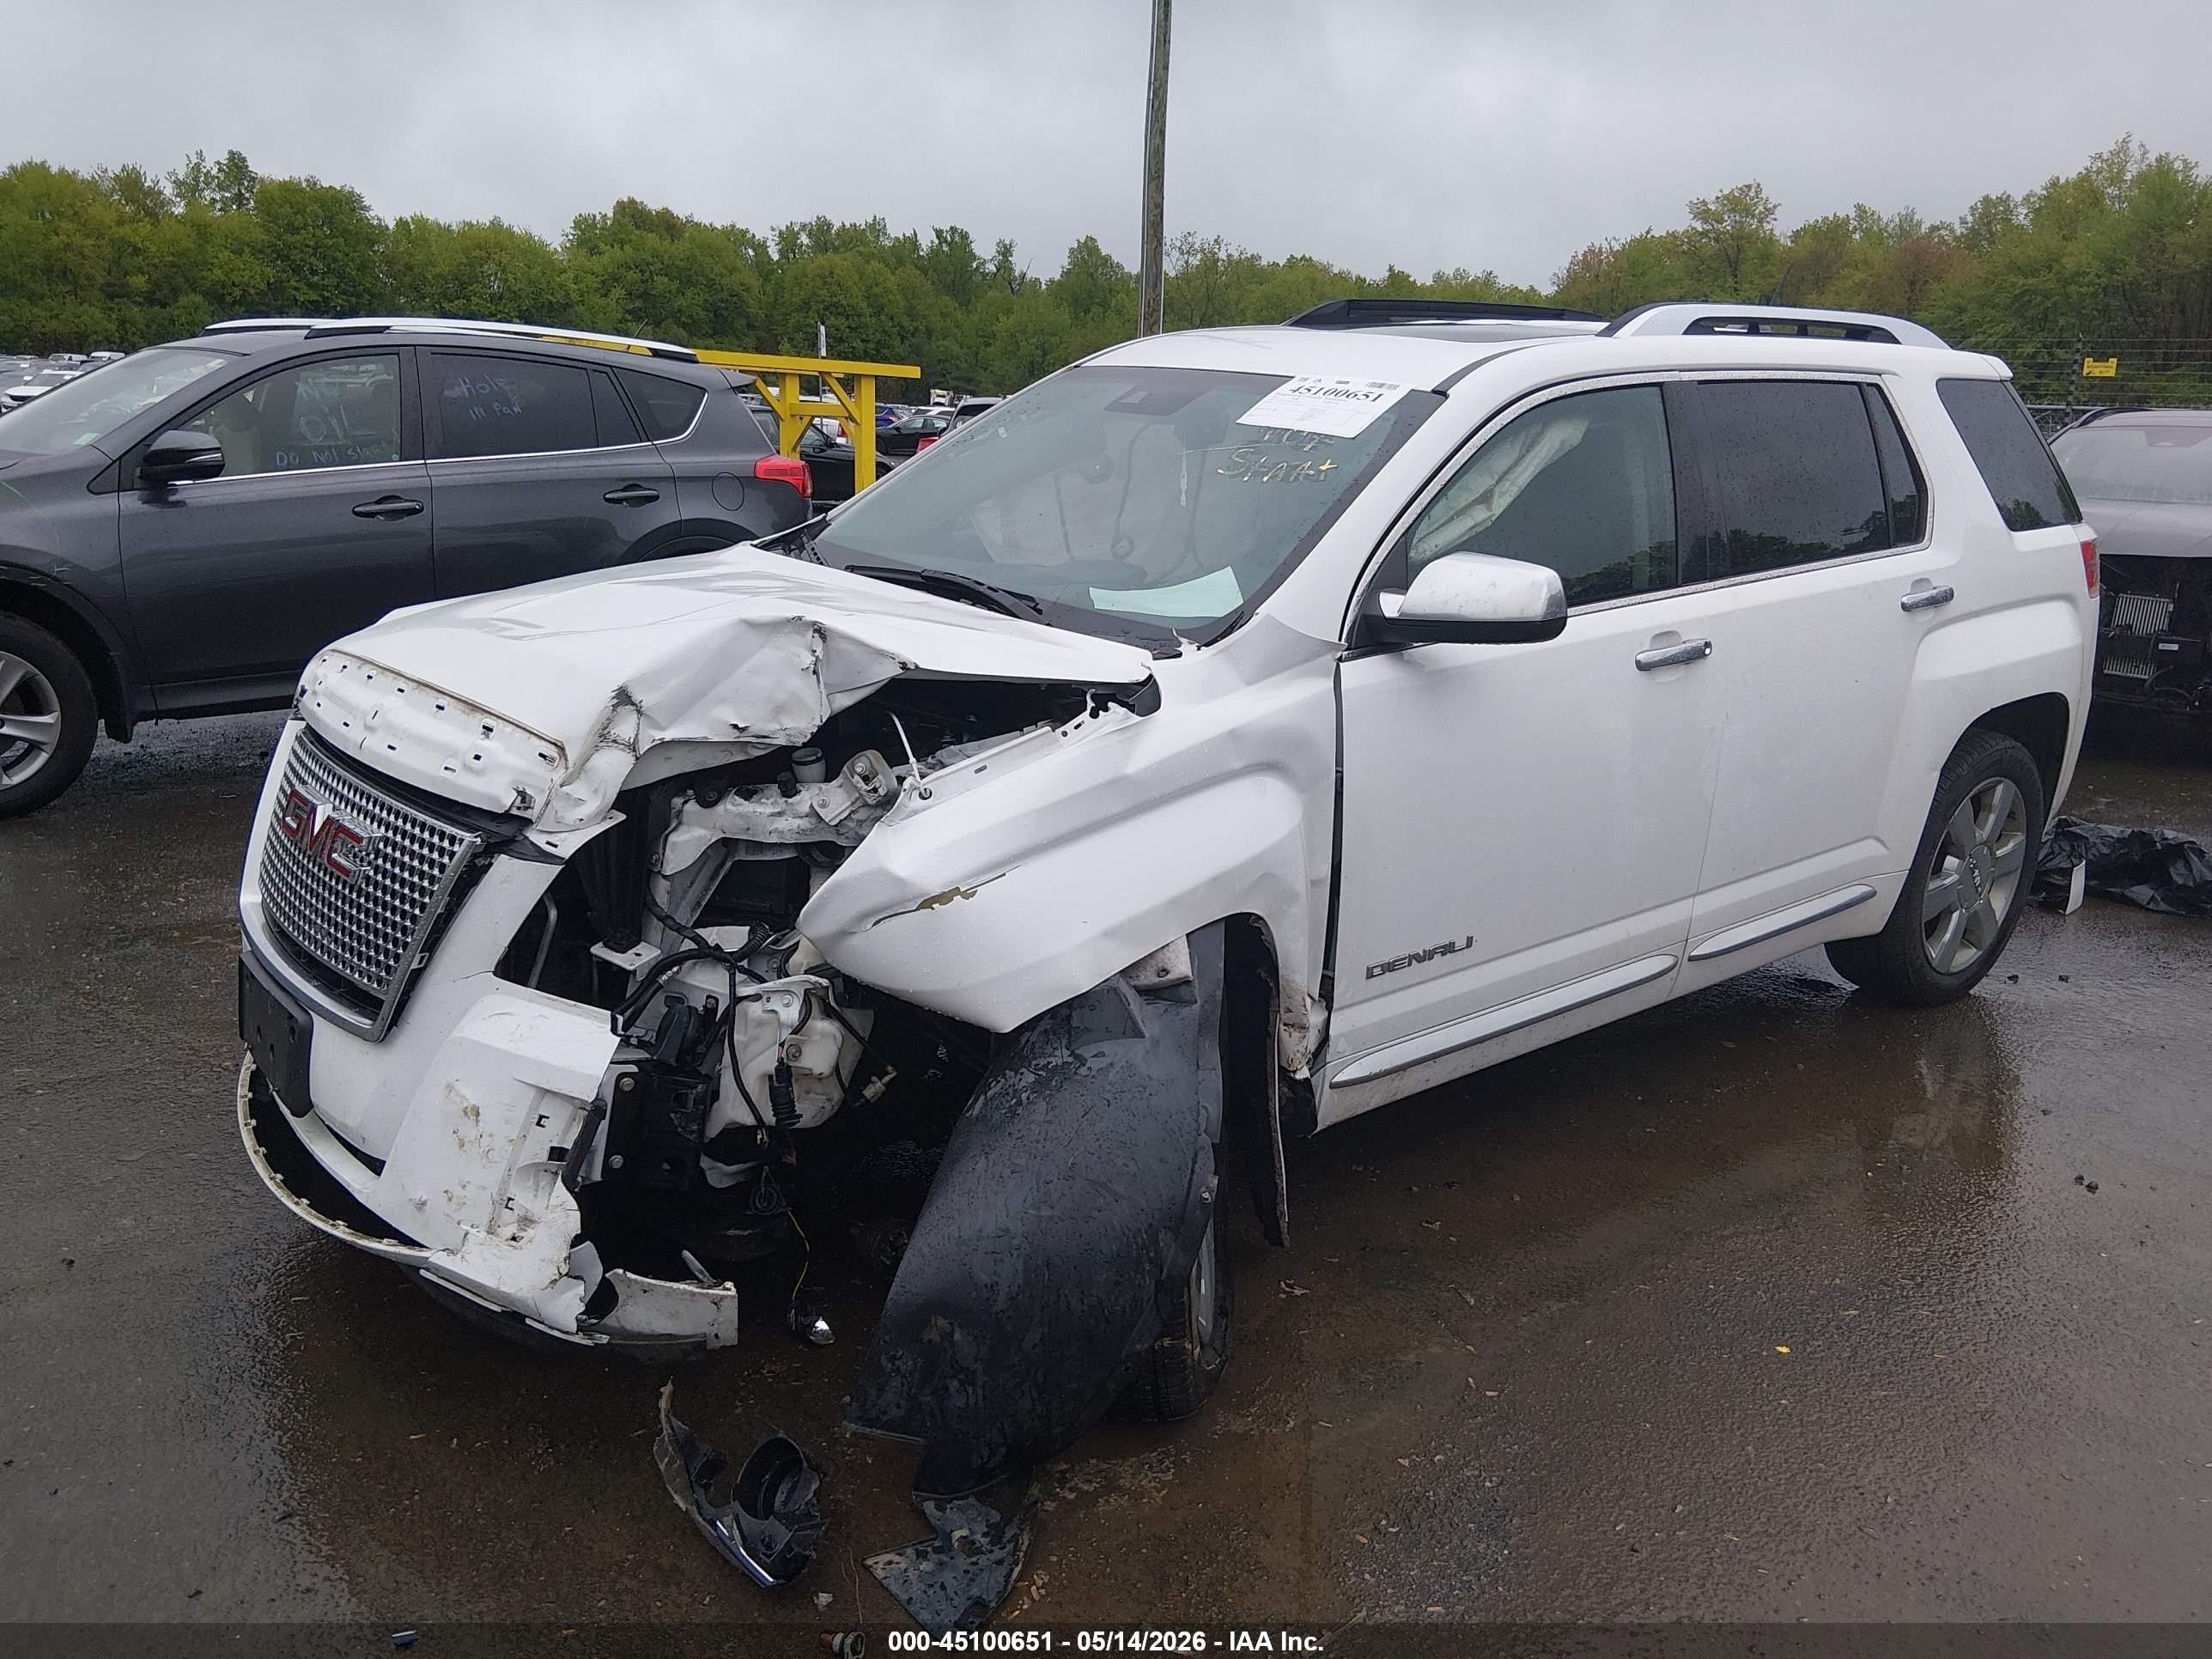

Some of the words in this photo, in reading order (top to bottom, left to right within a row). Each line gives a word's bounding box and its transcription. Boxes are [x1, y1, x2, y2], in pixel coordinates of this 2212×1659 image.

[1289, 385, 1384, 403] 45100651
[280, 783, 381, 878] GMC
[1365, 933, 1474, 980] DENALI
